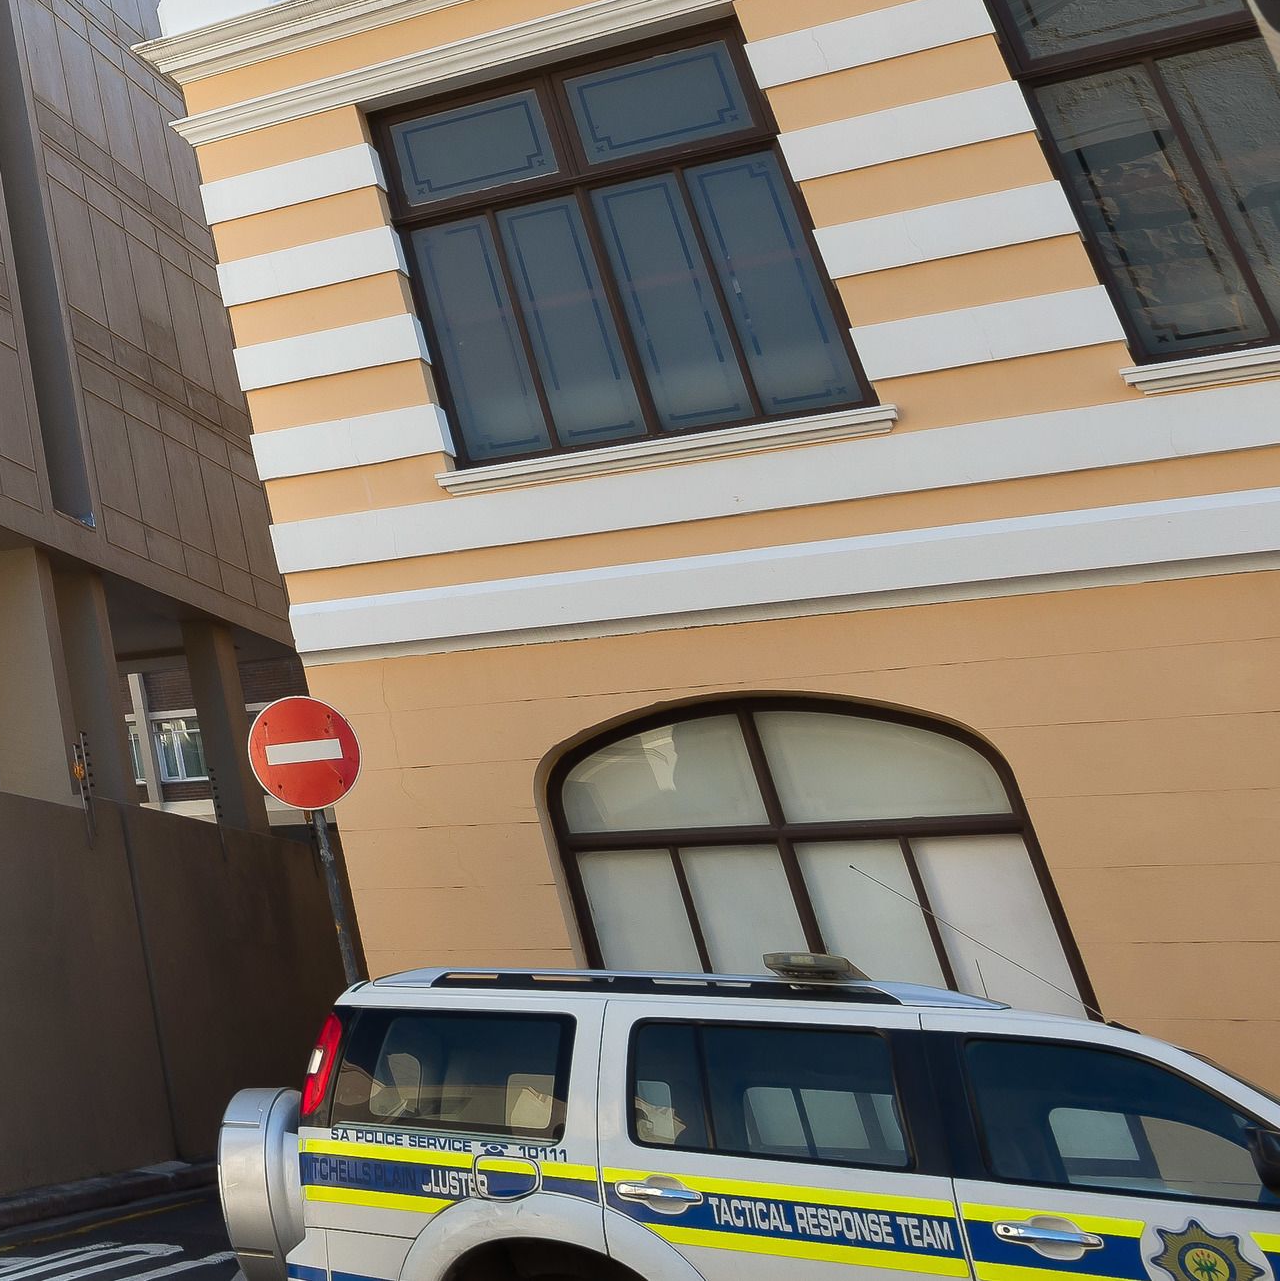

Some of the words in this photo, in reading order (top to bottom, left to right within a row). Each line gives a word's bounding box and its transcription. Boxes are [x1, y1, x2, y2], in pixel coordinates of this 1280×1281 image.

[330, 1128, 350, 1142] SA
[355, 1130, 403, 1146] POLICE
[408, 1135, 473, 1153] SERVICE
[518, 1145, 568, 1163] 10111
[374, 1163, 416, 1190] PLAIN
[422, 1168, 489, 1197] CLUSTER
[707, 1197, 793, 1233] TACTICAL
[793, 1205, 895, 1244] RESPONSE
[895, 1216, 955, 1251] TEAM
